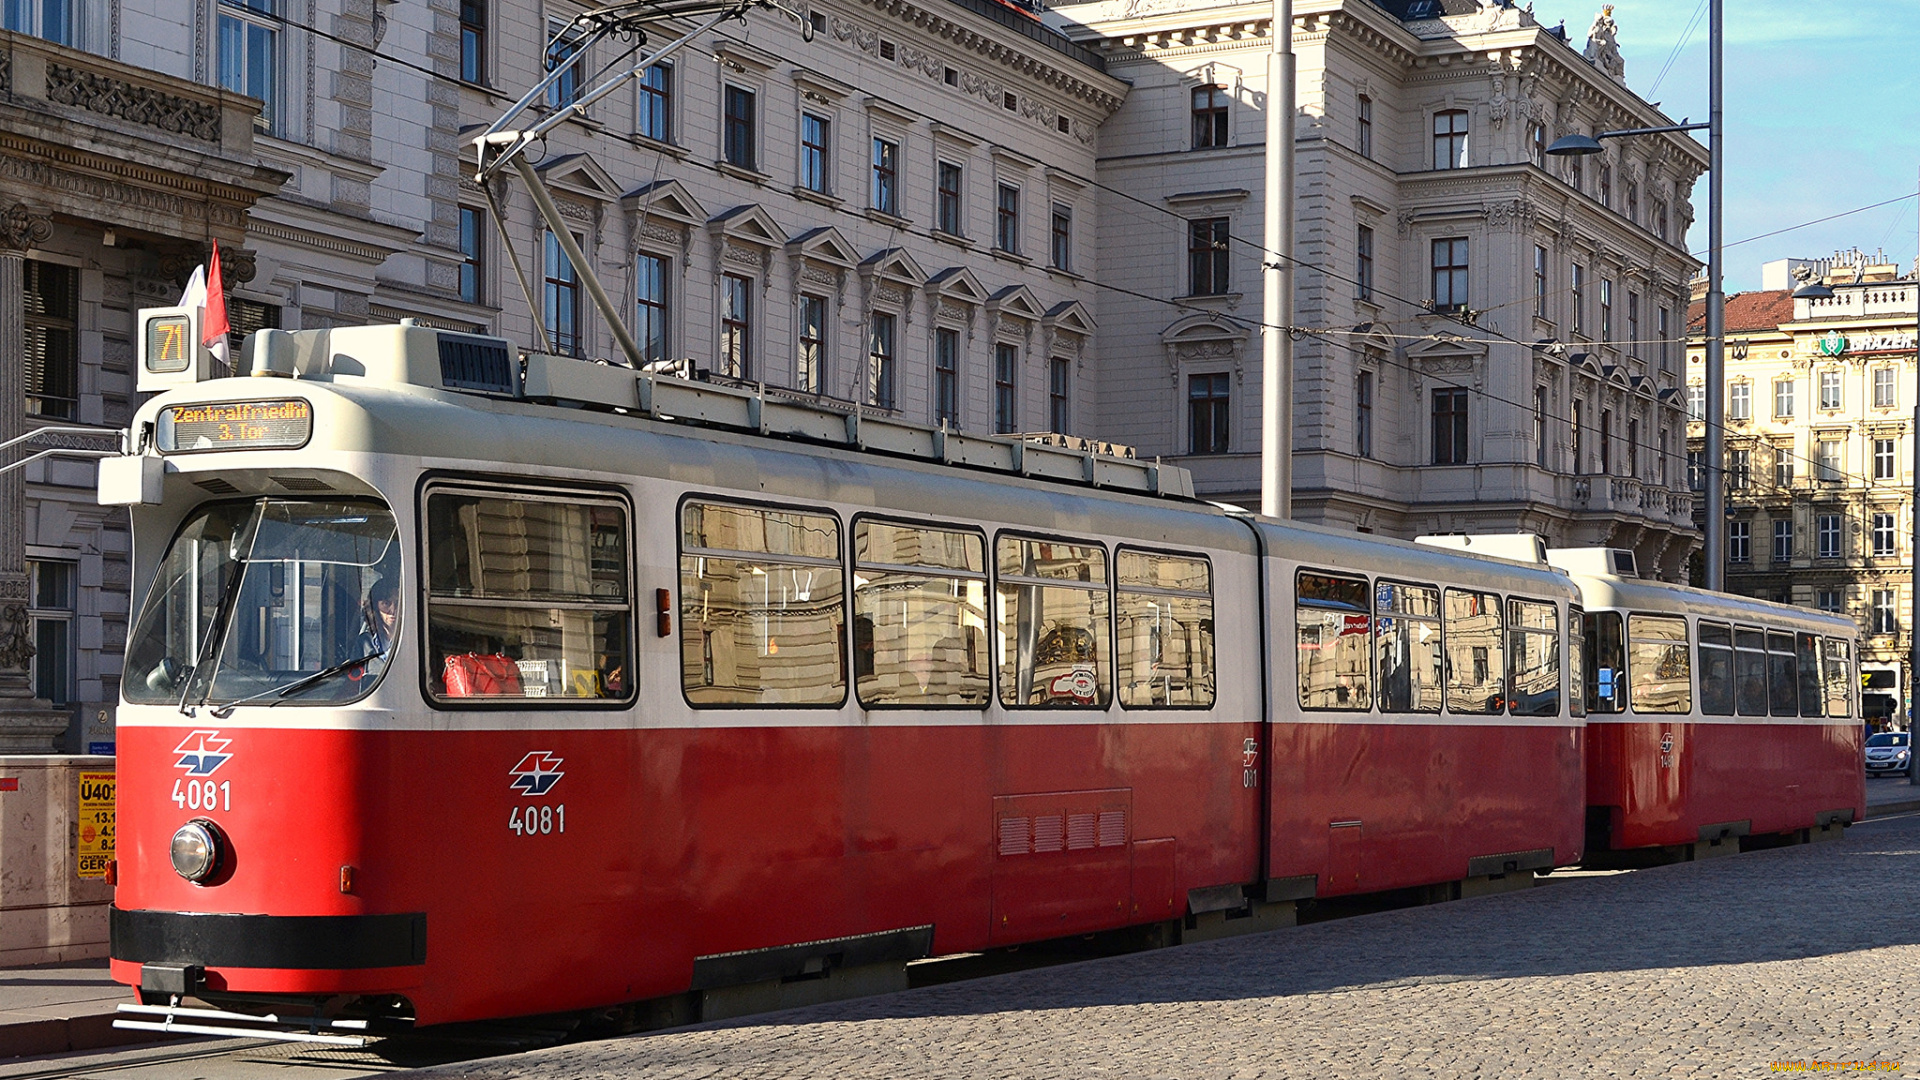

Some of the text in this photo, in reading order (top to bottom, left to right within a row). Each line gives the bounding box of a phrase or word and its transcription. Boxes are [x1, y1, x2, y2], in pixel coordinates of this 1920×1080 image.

[157, 324, 184, 361] 71
[218, 423, 270, 440] 3. Tor
[171, 778, 231, 812] 4081
[508, 803, 565, 836] 4081
[80, 859, 111, 870] GER
